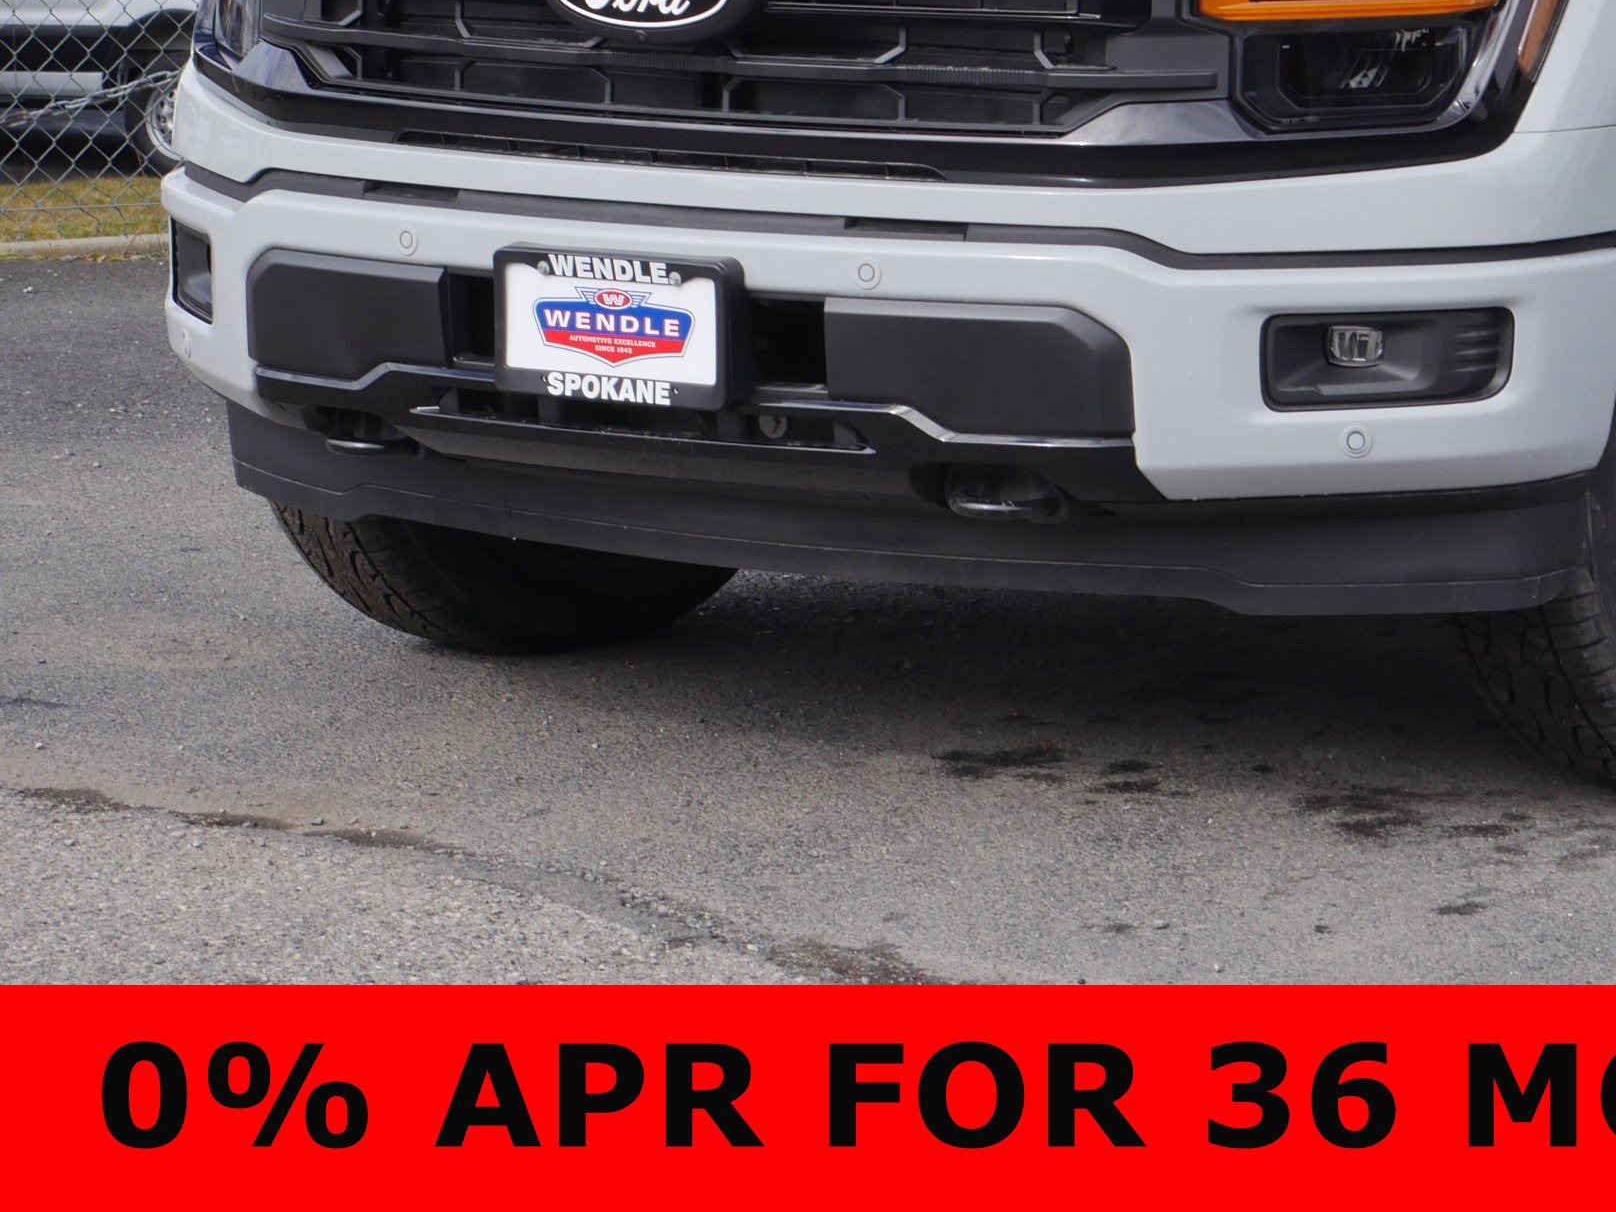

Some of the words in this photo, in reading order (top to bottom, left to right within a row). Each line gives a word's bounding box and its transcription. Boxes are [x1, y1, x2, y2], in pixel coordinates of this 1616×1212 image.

[548, 253, 670, 286] WENDLE
[602, 293, 625, 306] W
[543, 308, 680, 337] WENDLE
[569, 334, 613, 345] AUTOMOTIVE
[613, 338, 656, 348] EXCELLENCE
[594, 344, 615, 353] SINCE
[616, 346, 632, 354] 1943
[547, 371, 671, 406] SPOKANE
